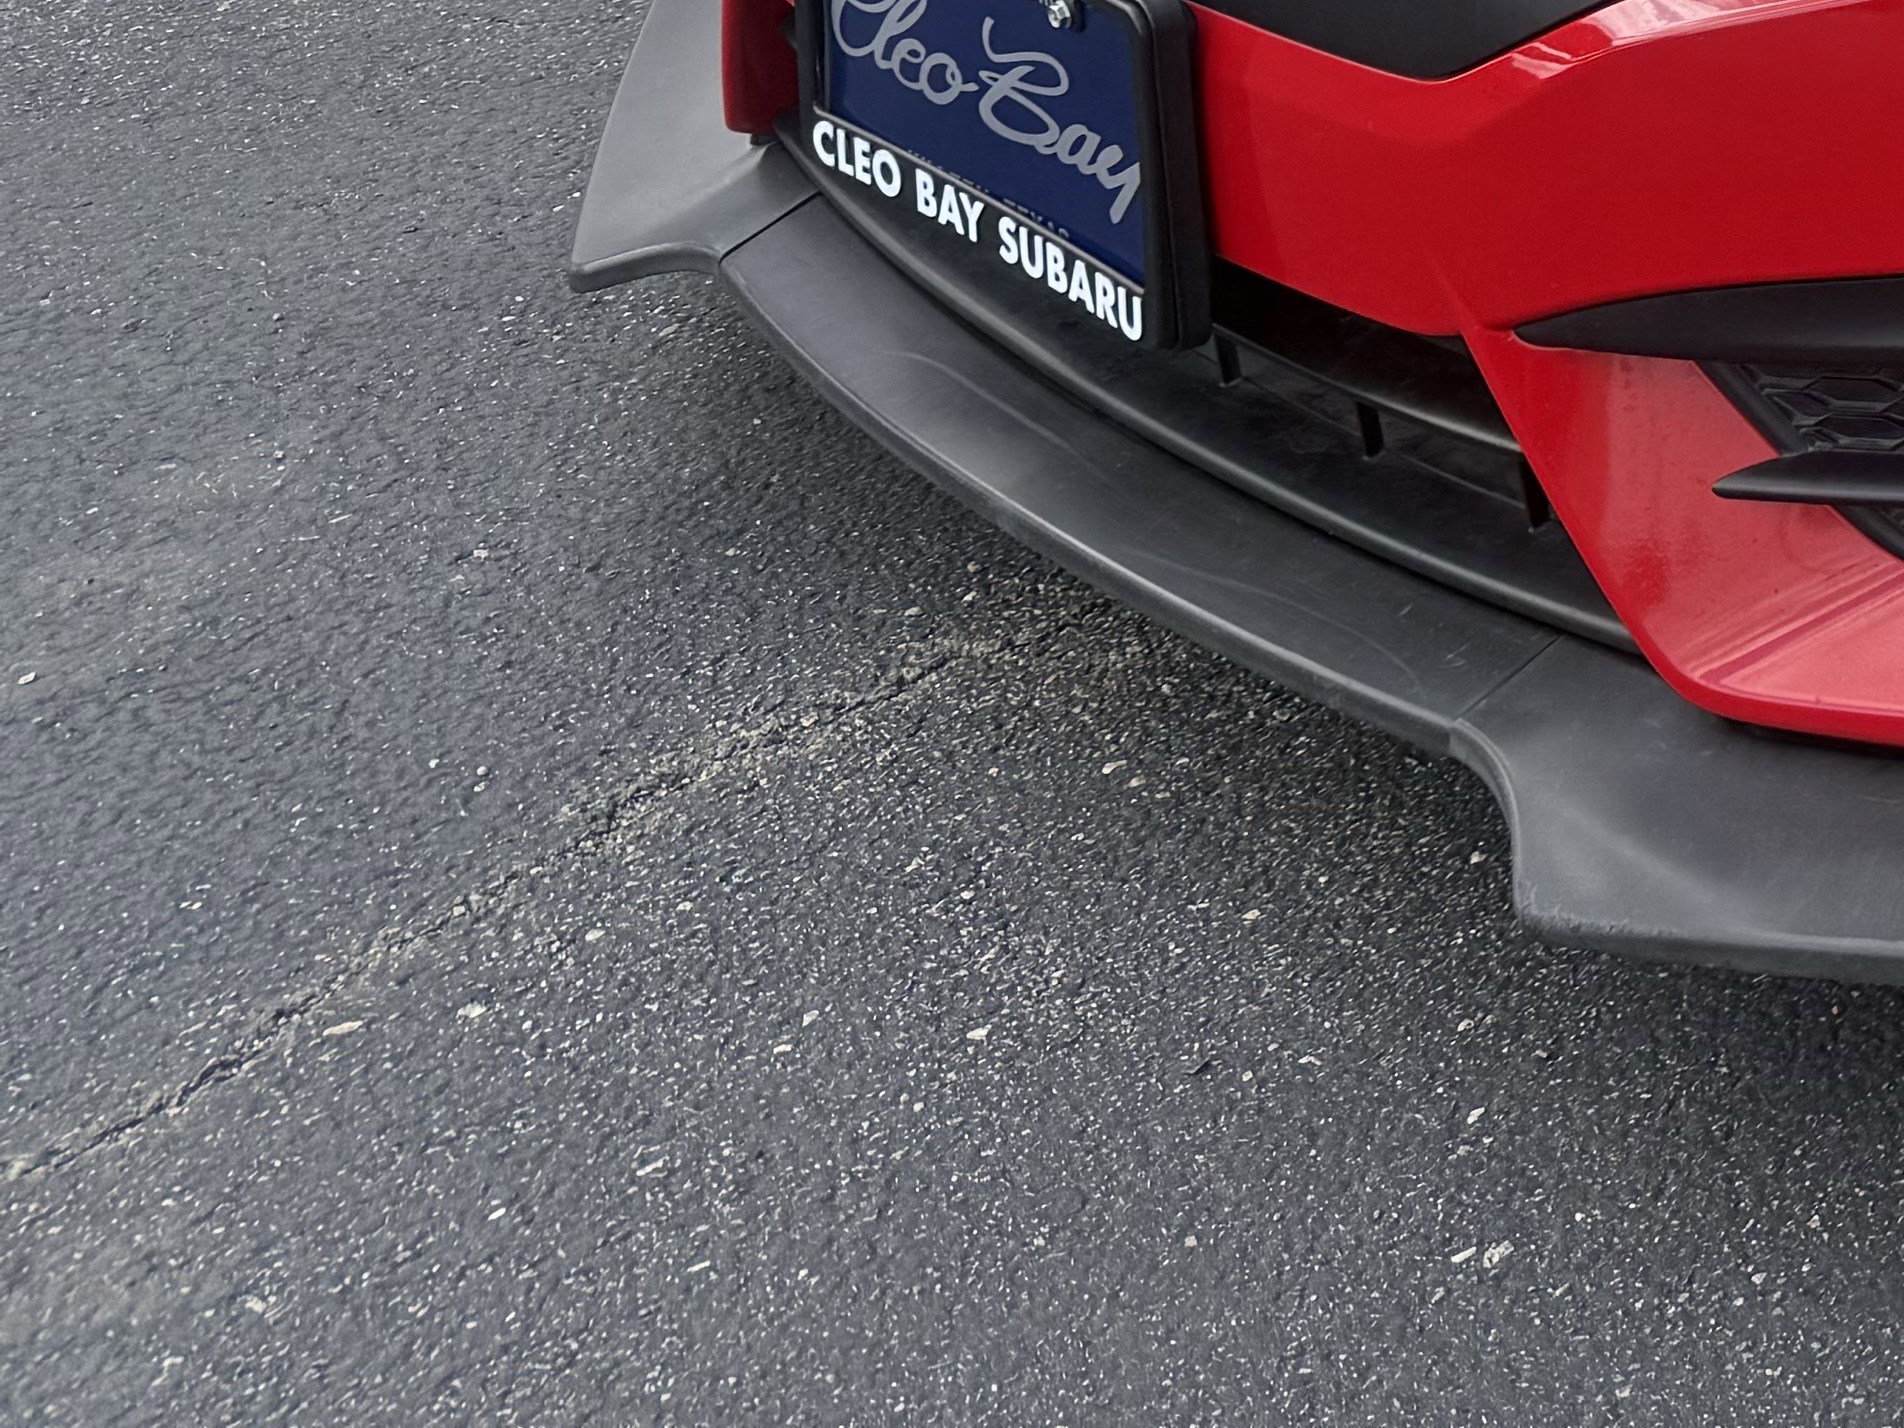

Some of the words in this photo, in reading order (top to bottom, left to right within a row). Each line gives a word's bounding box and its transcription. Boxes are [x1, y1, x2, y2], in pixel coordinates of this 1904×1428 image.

[978, 16, 1141, 224] Bay
[812, 120, 901, 197] CLEO
[915, 167, 984, 243] BAY
[998, 215, 1142, 341] SUBARU
